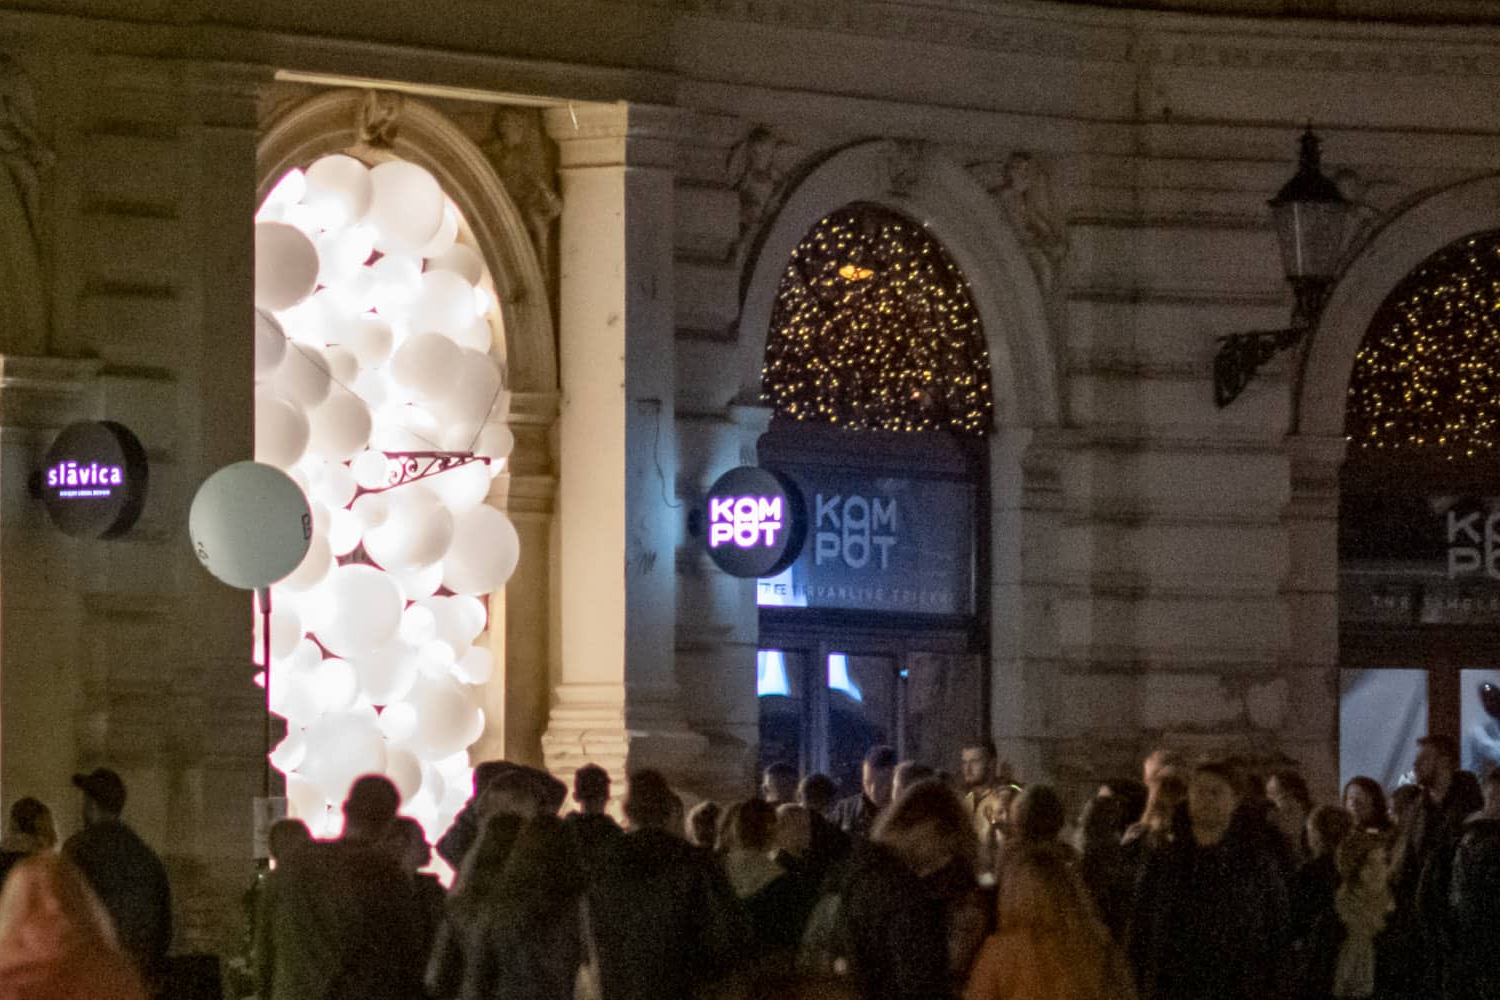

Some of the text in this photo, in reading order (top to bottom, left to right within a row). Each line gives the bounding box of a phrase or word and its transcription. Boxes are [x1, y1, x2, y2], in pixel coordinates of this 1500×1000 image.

[710, 497, 781, 522] KOM
[815, 494, 897, 531] KOM
[710, 522, 781, 547] POT
[815, 532, 897, 570] POT
